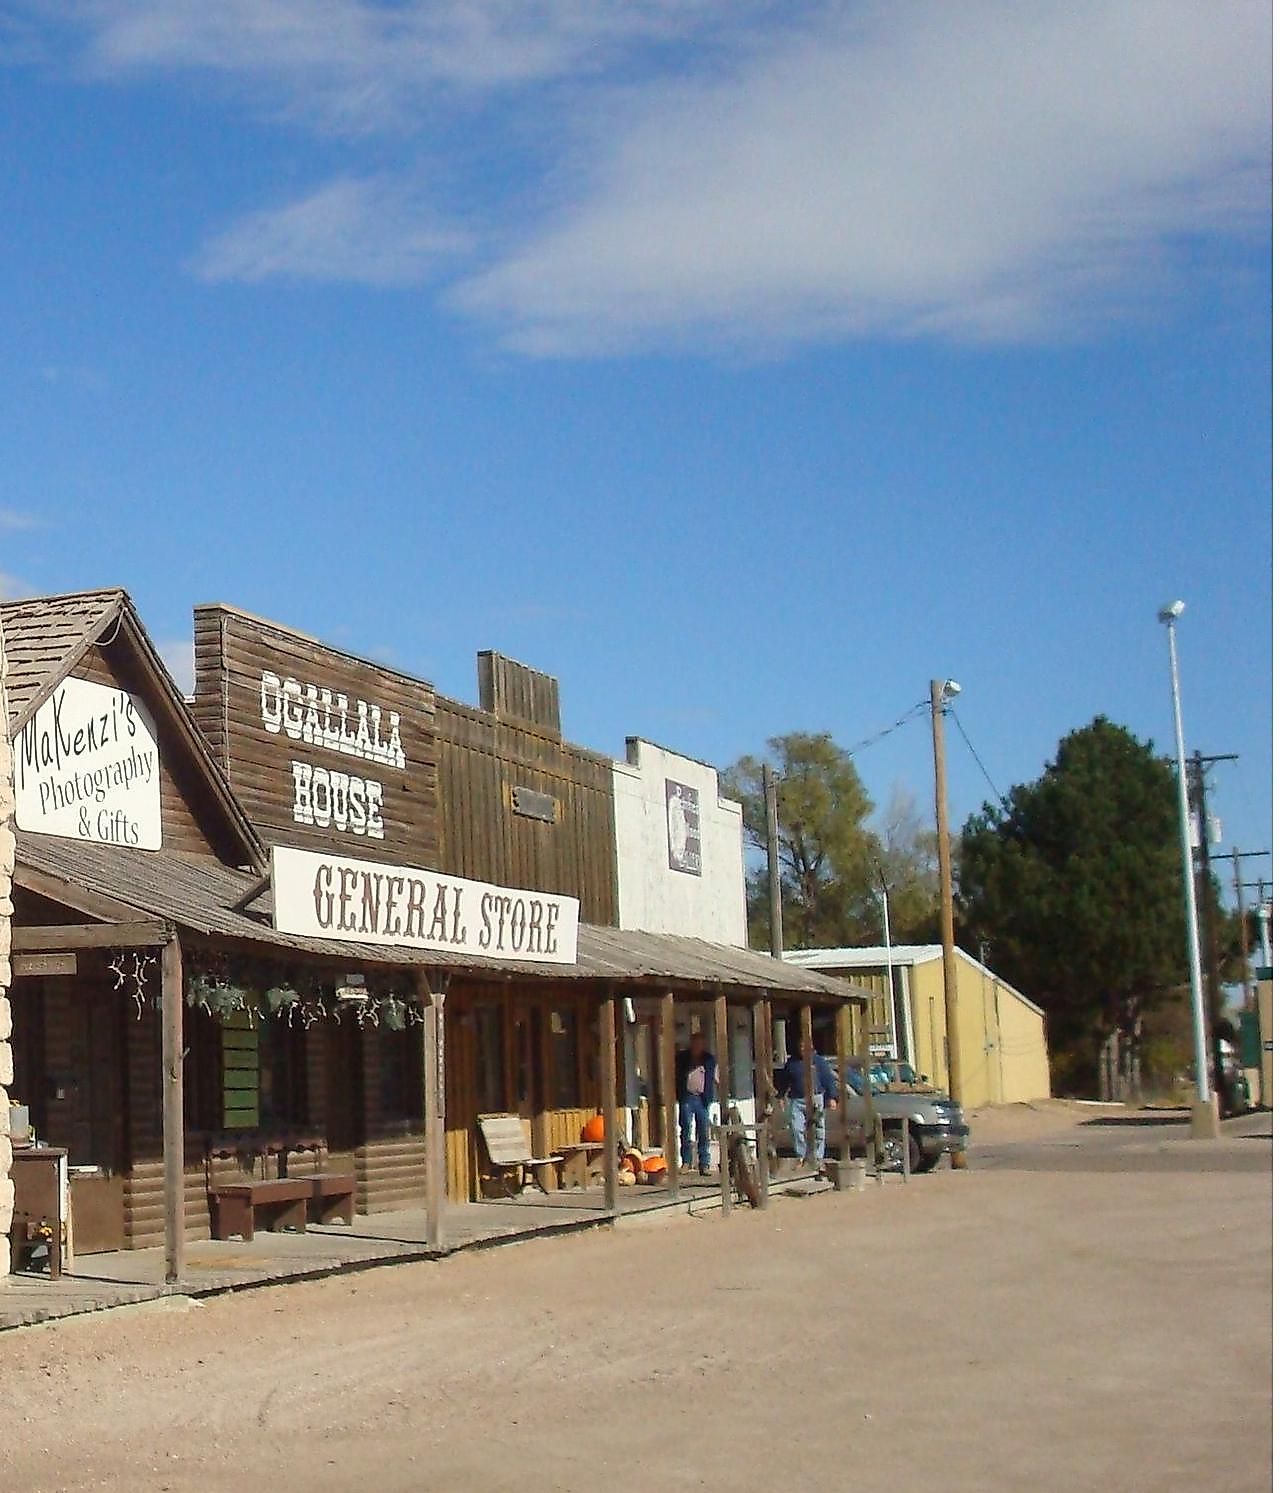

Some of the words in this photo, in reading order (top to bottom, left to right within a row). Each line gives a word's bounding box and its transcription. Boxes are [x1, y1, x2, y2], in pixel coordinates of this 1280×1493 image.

[261, 670, 406, 769] OGALLALA
[39, 746, 153, 815] Photography
[292, 760, 385, 840] HOUSE
[78, 805, 91, 837] &
[97, 809, 139, 845] Gifts
[313, 863, 467, 945] GENERAL
[479, 891, 560, 955] STORE
